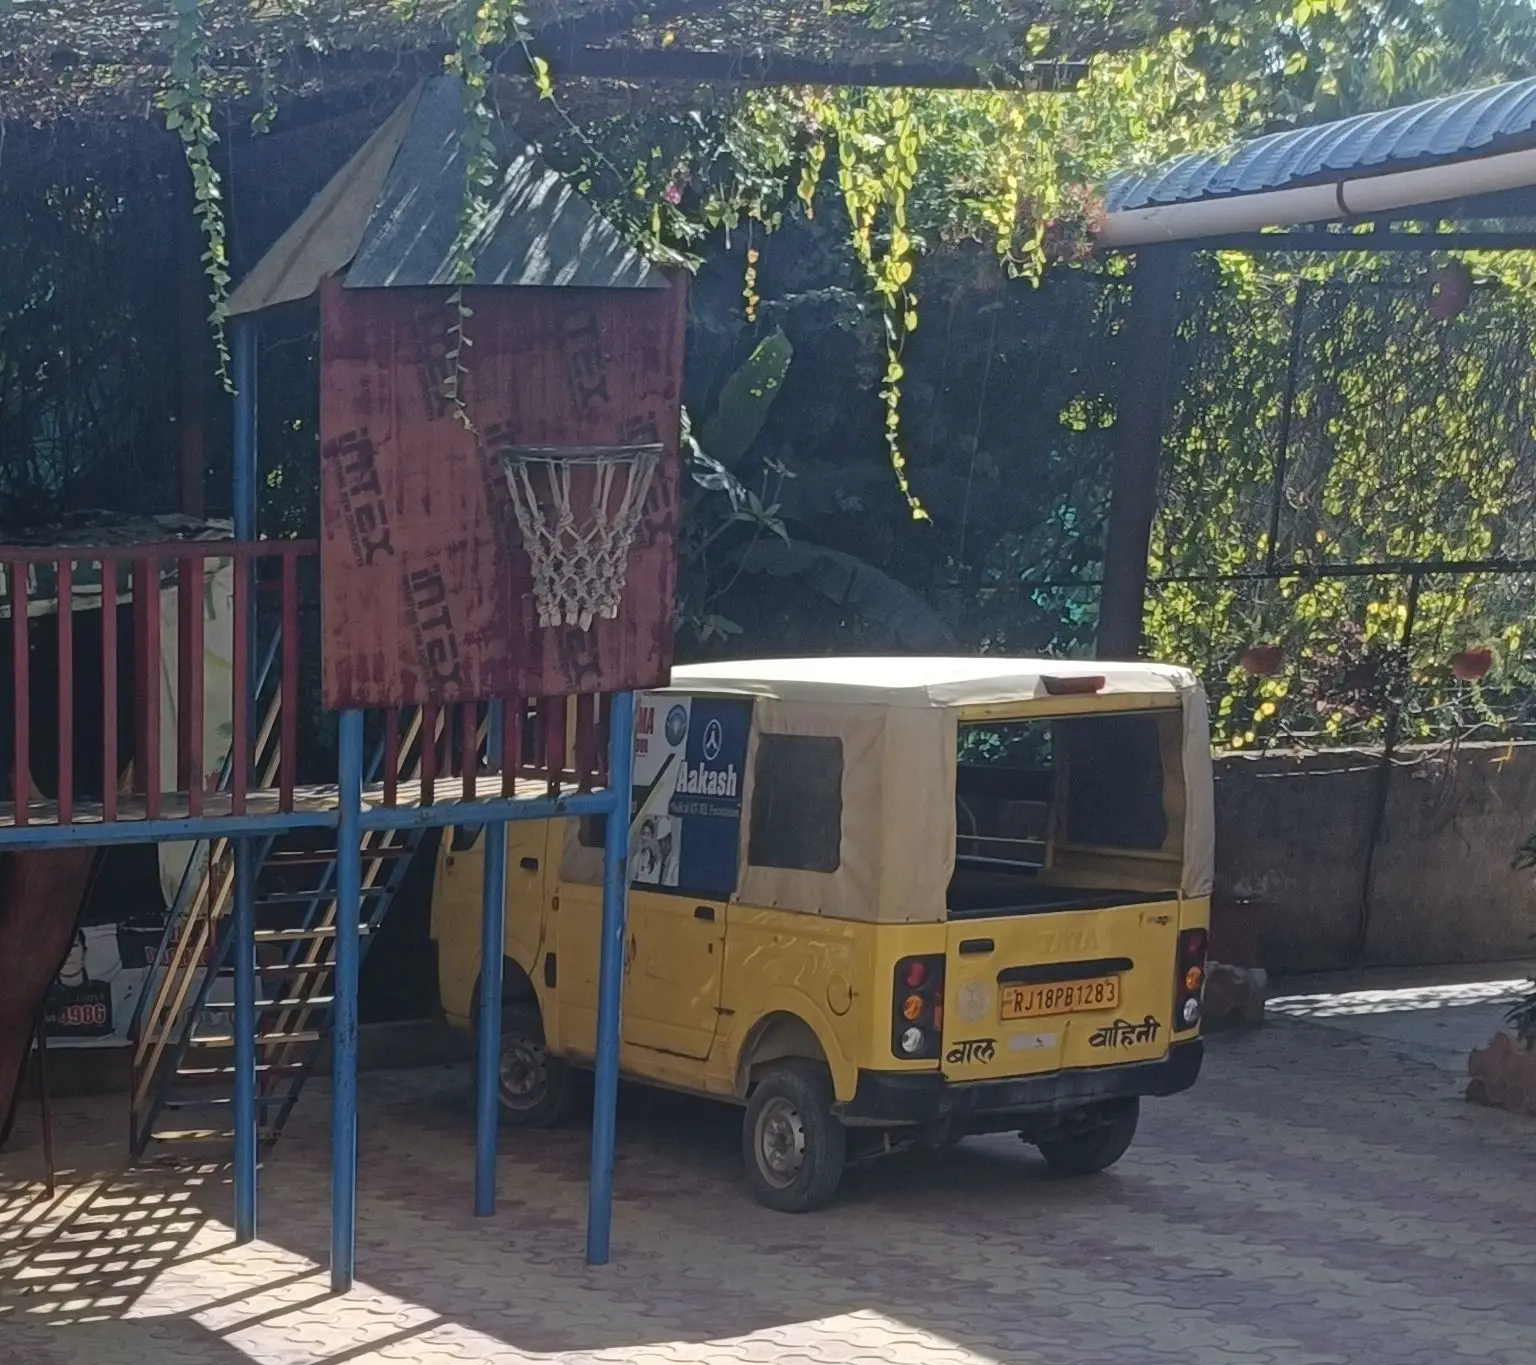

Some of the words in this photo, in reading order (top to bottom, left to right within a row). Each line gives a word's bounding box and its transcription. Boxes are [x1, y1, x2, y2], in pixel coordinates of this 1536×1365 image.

[676, 761, 737, 797] Aakash
[1013, 982, 1116, 1013] RJ18PB1283
[946, 1036, 998, 1064] बाल
